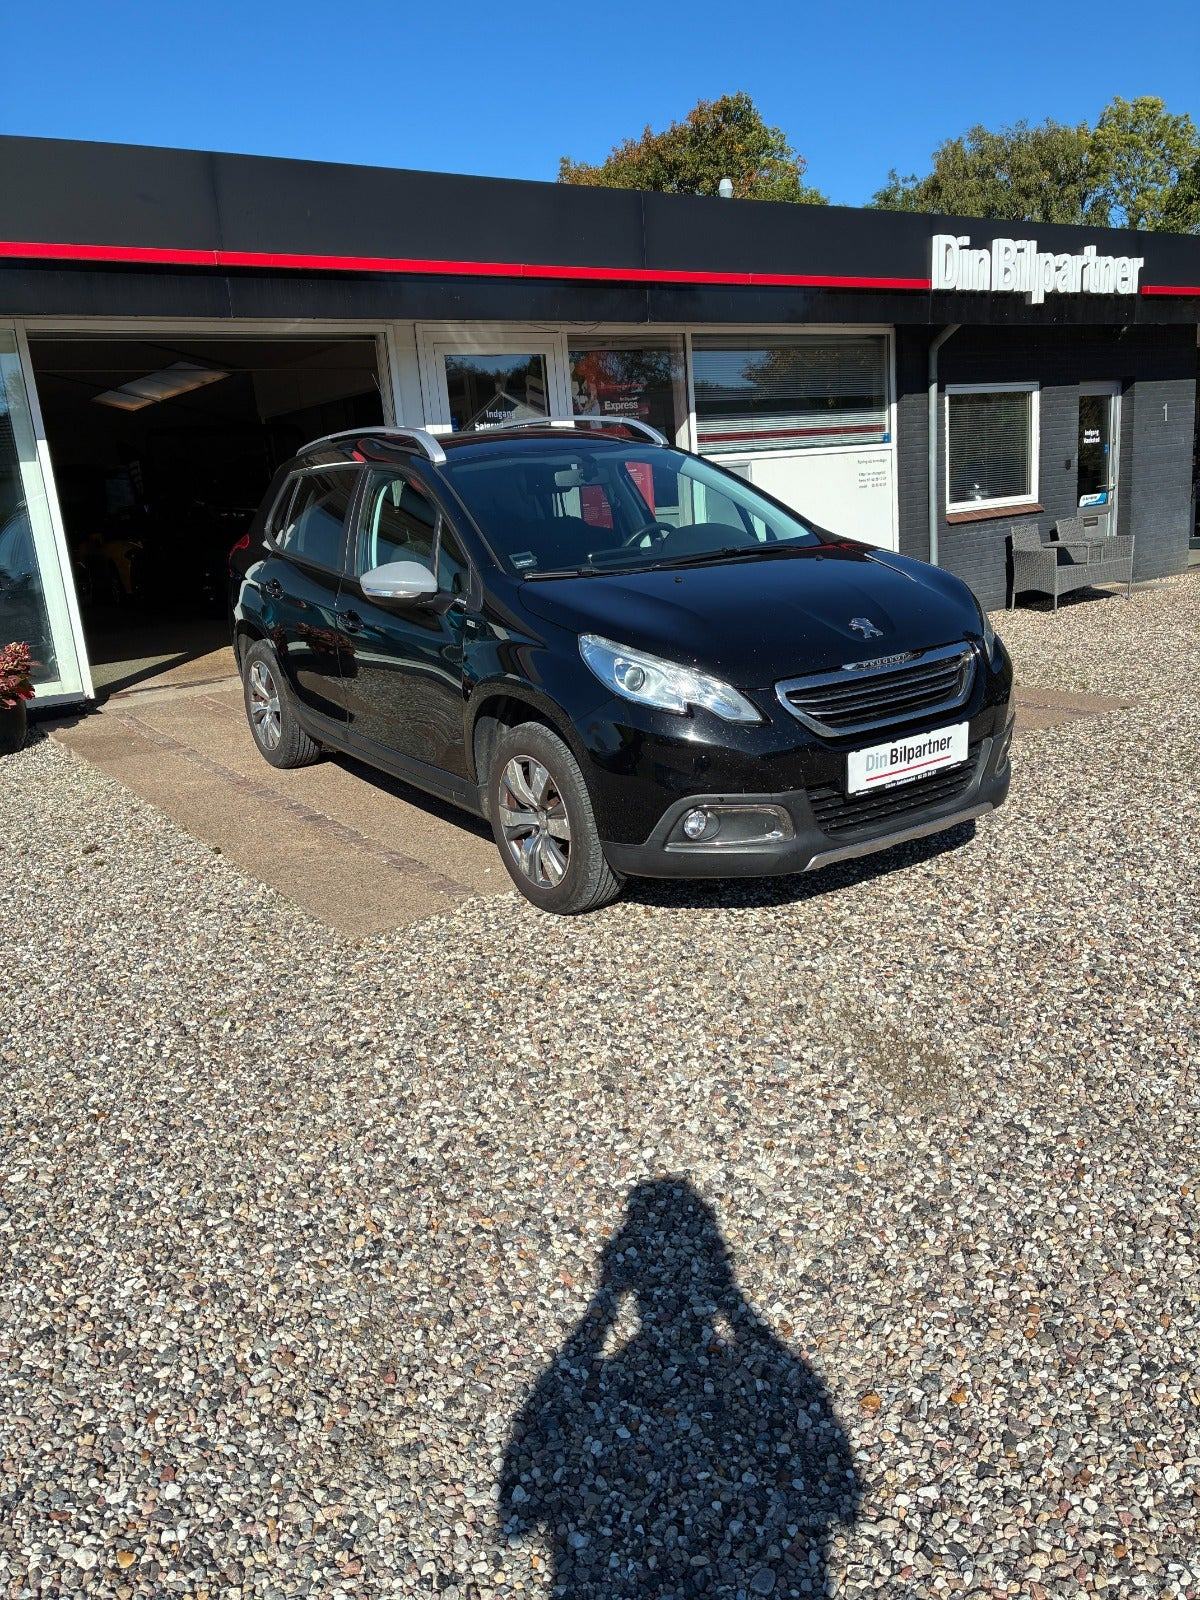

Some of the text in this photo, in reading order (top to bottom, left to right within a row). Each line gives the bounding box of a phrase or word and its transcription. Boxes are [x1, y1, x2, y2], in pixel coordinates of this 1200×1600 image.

[931, 234, 1144, 304] Din Bilpartner
[486, 409, 515, 420] Indgang
[604, 400, 639, 412] Express
[1162, 404, 1168, 421] 1
[865, 736, 952, 772] Din Bilpartner
